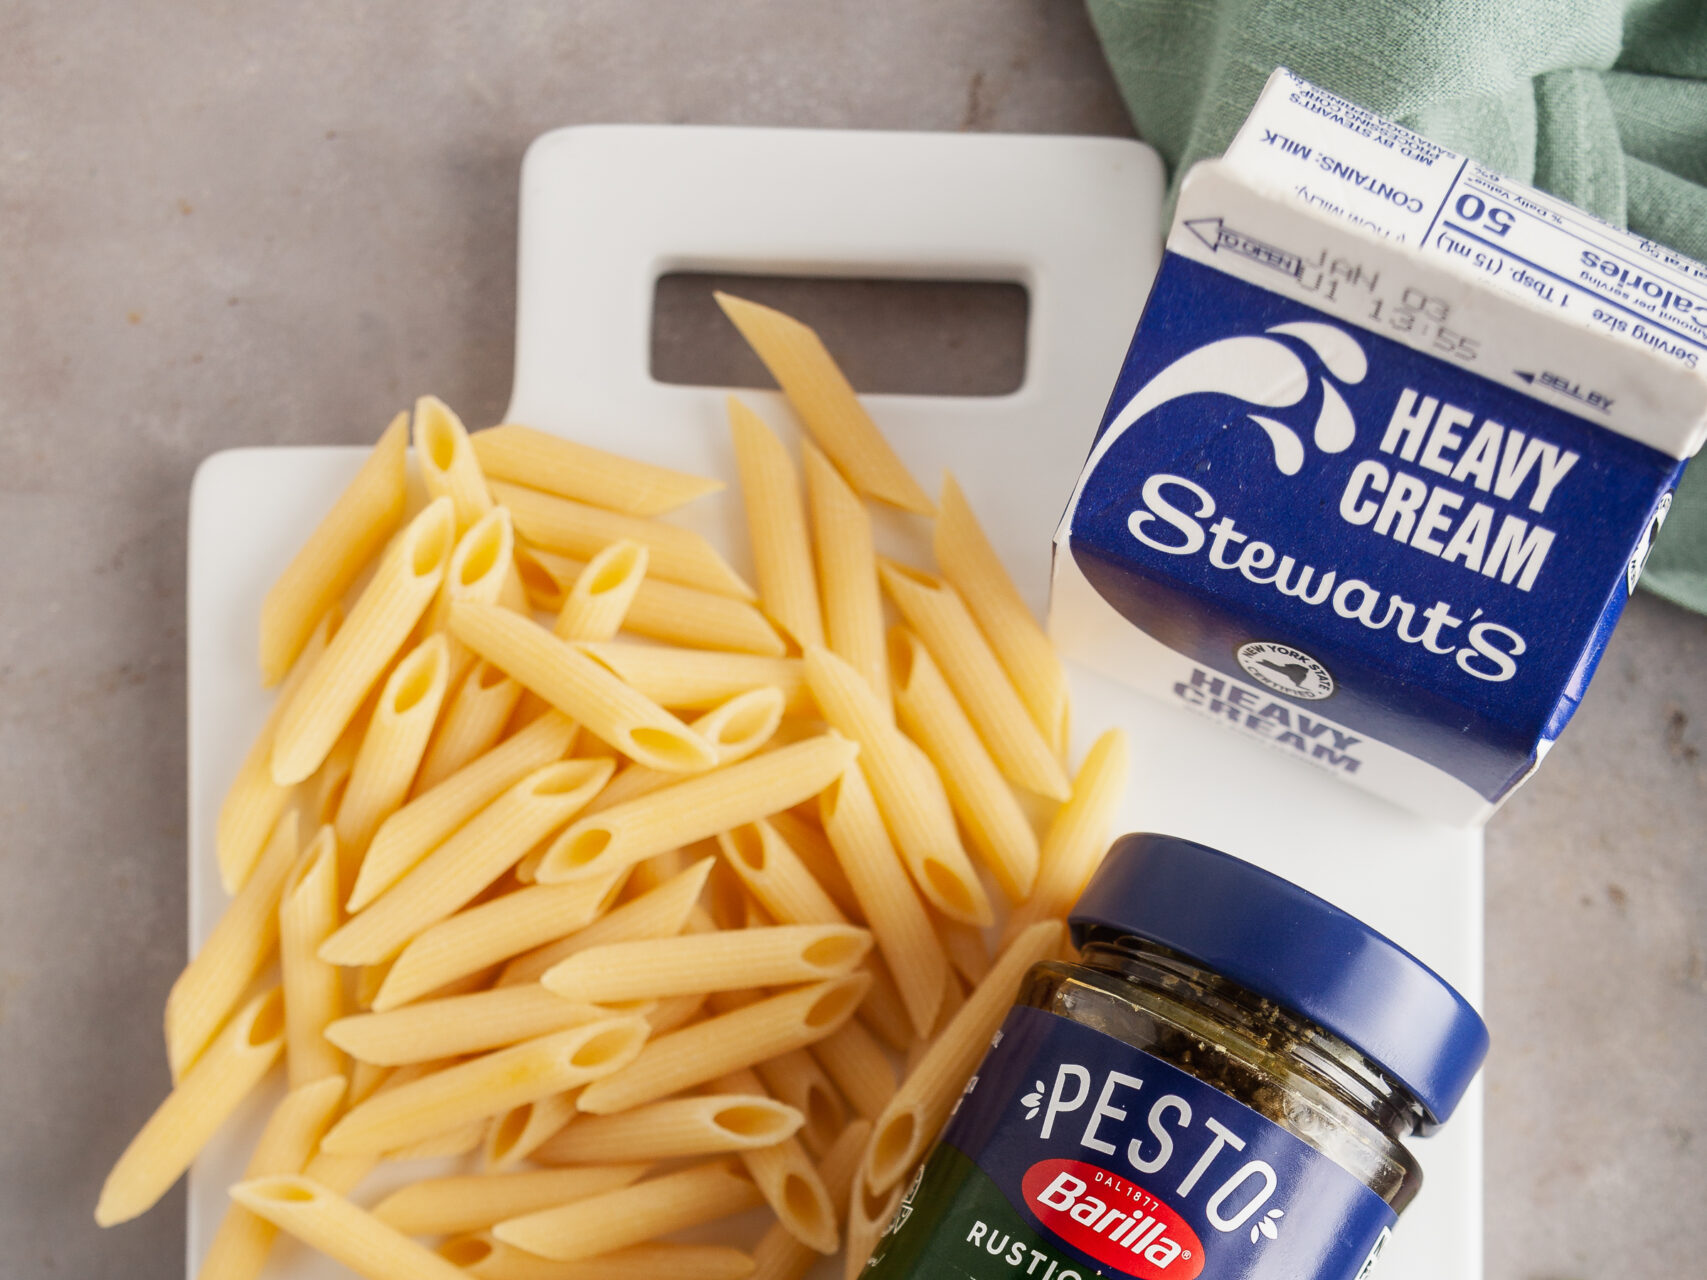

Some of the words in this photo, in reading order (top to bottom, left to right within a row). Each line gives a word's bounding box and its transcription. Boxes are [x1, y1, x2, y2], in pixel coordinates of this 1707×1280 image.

[1289, 92, 1373, 139] STEWART'S
[1260, 128, 1313, 161] MILK
[1344, 110, 1441, 161] PROCESSING
[1374, 135, 1396, 149] BY
[1400, 146, 1434, 167] MFD.
[1315, 151, 1424, 215] CONTAINS:
[1455, 193, 1517, 237] 50
[1514, 195, 1548, 217] Daily
[1242, 239, 1293, 271] OPEN
[1436, 231, 1472, 257] mL)
[1473, 252, 1504, 276] (15
[1303, 249, 1380, 293] JAN
[1402, 286, 1450, 322] 03
[1509, 266, 1554, 302] Tbsp.
[1559, 294, 1569, 307] 1
[1580, 270, 1630, 299] serving
[1592, 309, 1628, 332] size
[1634, 298, 1657, 313] per
[1632, 324, 1699, 369] Serving
[1586, 387, 1616, 412] BY
[1379, 387, 1581, 514] HEAVY
[1339, 459, 1557, 592] CREAM
[1242, 644, 1267, 659] NEW
[1266, 644, 1310, 664] YORK
[1308, 663, 1332, 692] STATE
[1246, 665, 1317, 699] CERTIFIED
[1172, 681, 1363, 774] CREAM
[1190, 668, 1363, 751] HEAVY
[1040, 1063, 1278, 1233] PESTO
[1095, 1171, 1122, 1193] DAL
[1126, 1186, 1160, 1213] 1877
